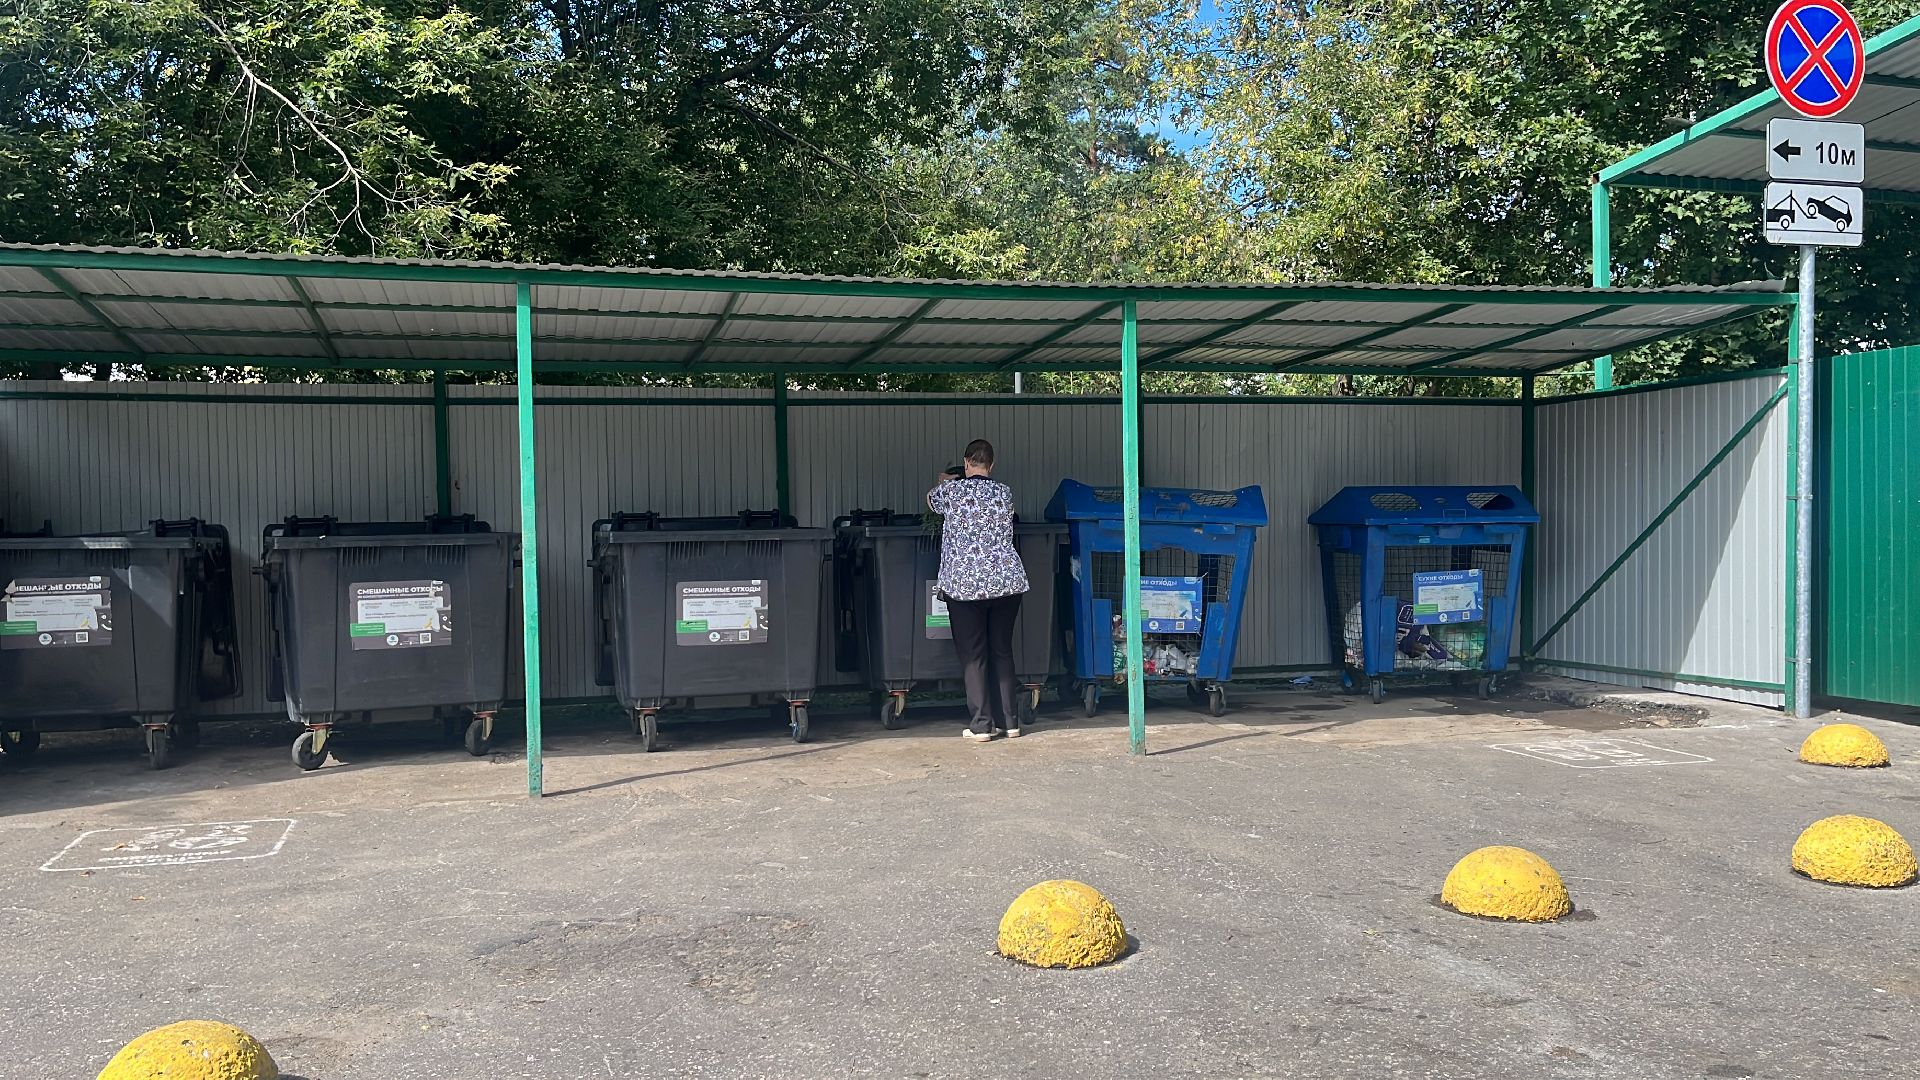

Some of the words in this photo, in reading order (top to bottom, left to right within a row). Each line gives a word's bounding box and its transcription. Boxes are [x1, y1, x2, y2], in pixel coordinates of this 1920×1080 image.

[65, 582, 102, 590] ОТХОДЫ
[357, 586, 409, 595] СМЕШАННЫЕ
[683, 586, 730, 594] СМЕШАННЫЕ
[731, 585, 761, 593] ОТХОДЫ
